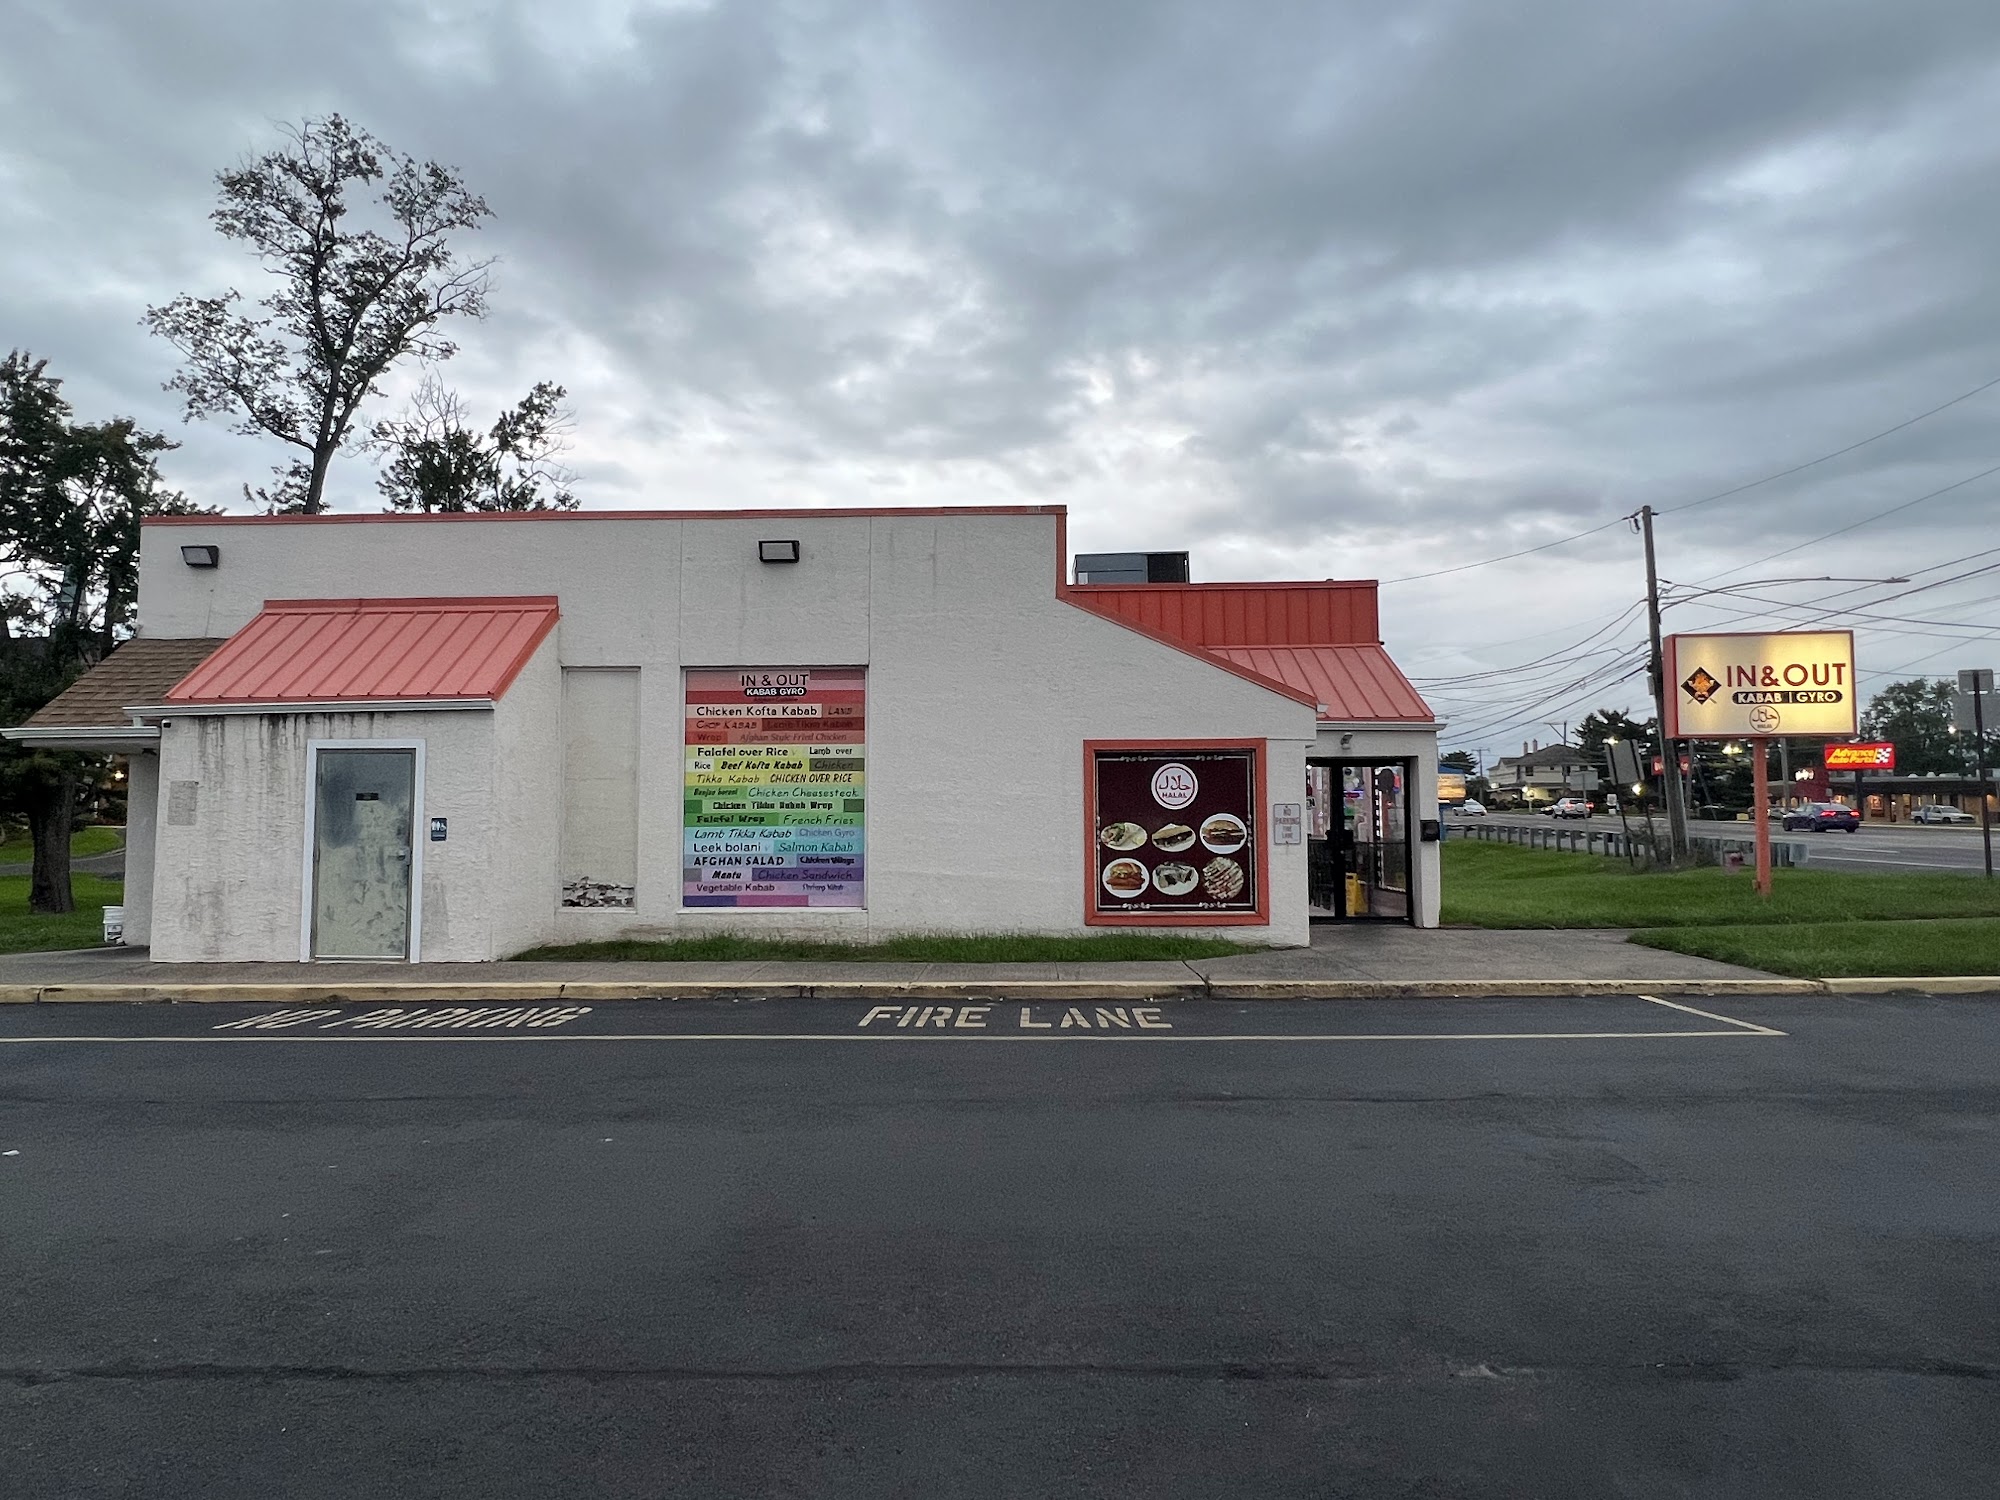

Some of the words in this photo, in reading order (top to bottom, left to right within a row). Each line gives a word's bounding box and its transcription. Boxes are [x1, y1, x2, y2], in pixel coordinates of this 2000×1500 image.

[741, 675, 755, 686] IN
[761, 675, 771, 686] &
[776, 674, 809, 686] OUT
[1727, 663, 1846, 687] IN&OUT
[1736, 692, 1782, 703] KABAB
[1796, 691, 1837, 703] GYRO
[696, 707, 741, 716] Chicken
[746, 706, 777, 716] Kofta
[782, 706, 817, 716] Kabab
[1752, 709, 1777, 722] حلال
[724, 721, 757, 729] KABAB
[697, 734, 721, 742] Wrap
[740, 734, 768, 743] Afghan
[816, 733, 846, 741] Chicken
[698, 748, 735, 756] Falafel
[766, 747, 788, 756] Rice
[810, 747, 830, 756] Lamb
[1835, 748, 1874, 756] Advance
[694, 762, 711, 770] Rice
[721, 761, 742, 770] Beef
[745, 761, 770, 770] Kofta
[774, 761, 803, 769] Kabab
[814, 760, 853, 769] Chicken
[697, 775, 722, 783] Tikka
[728, 775, 759, 783] Kabab
[770, 774, 806, 783] CHICKEN
[809, 774, 829, 783] OVER
[833, 774, 852, 782] RICE
[1158, 775, 1191, 791] حلال
[748, 788, 789, 797] Chicken
[810, 802, 833, 810] Wrap
[738, 816, 765, 824] Wrap
[783, 815, 822, 825] French
[825, 814, 854, 825] Fries
[694, 830, 725, 838] Lamb
[728, 829, 755, 838] Tikka
[759, 829, 792, 838] Kabab
[834, 829, 854, 838] Gyro
[694, 843, 721, 852] Leek
[725, 842, 761, 852] bolani
[779, 843, 817, 851] Salmon
[820, 842, 853, 851] Kabab
[694, 857, 742, 865] AFGHAN
[745, 857, 784, 865] SALAD
[757, 871, 799, 880] Chicken
[802, 870, 853, 880] Sandwich
[696, 884, 742, 893] Vegetable
[317, 1007, 593, 1029] PARKING
[857, 1006, 991, 1028] FIRE
[1019, 1007, 1173, 1029] LANE
